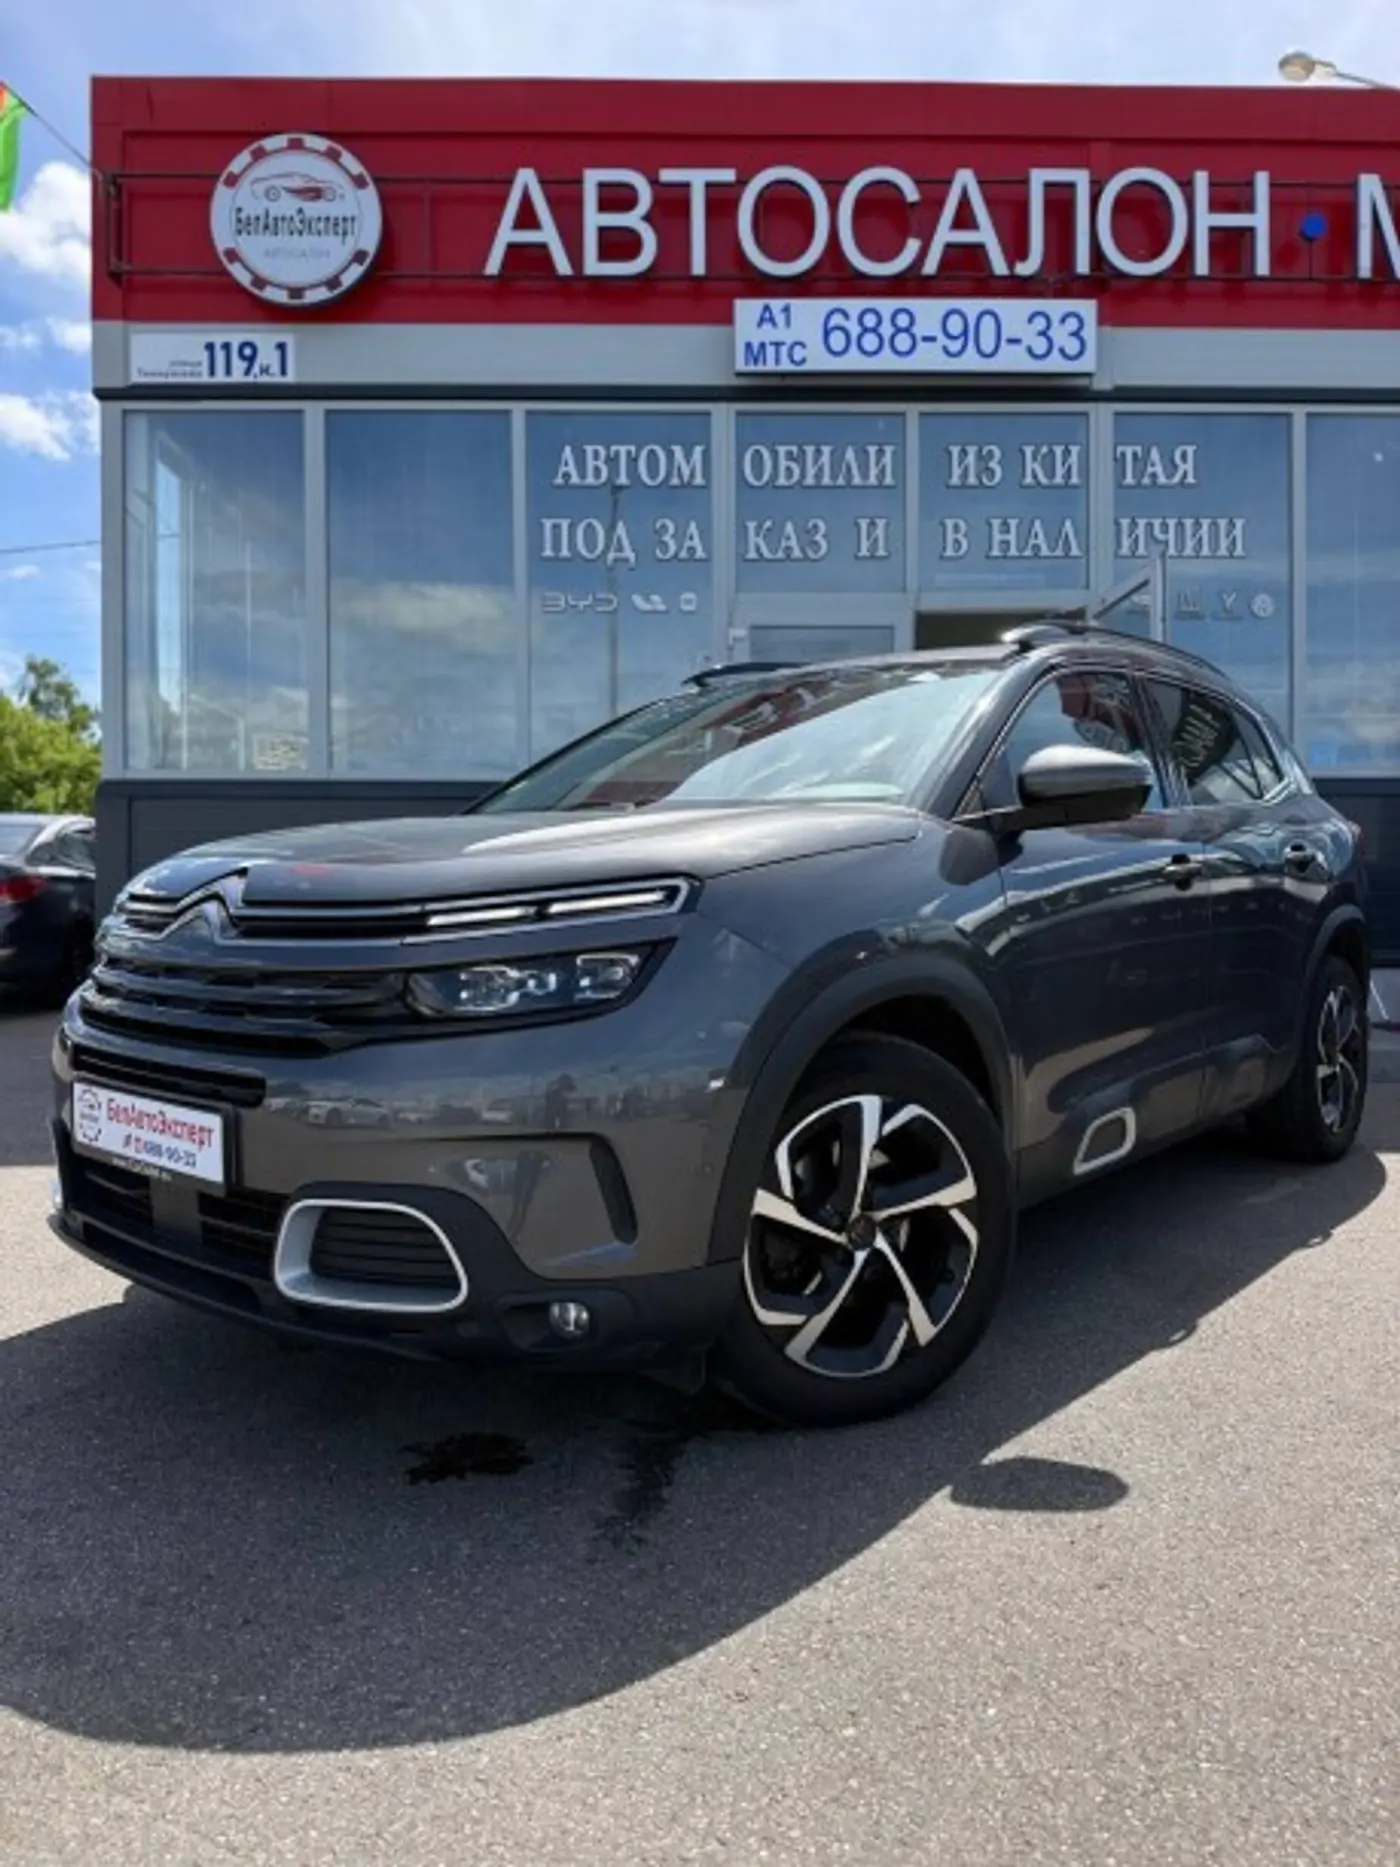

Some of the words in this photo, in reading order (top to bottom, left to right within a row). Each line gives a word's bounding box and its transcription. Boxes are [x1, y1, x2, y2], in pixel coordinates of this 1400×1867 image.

[235, 206, 357, 245] БелАвтоЭксперт
[484, 166, 1271, 278] АВТОСАЛОН
[743, 341, 807, 366] МТС
[822, 307, 1087, 361] 688-90-33
[949, 445, 1003, 487] ИЗ
[540, 518, 636, 567] ПОД
[856, 518, 891, 558] И
[942, 518, 968, 558] В
